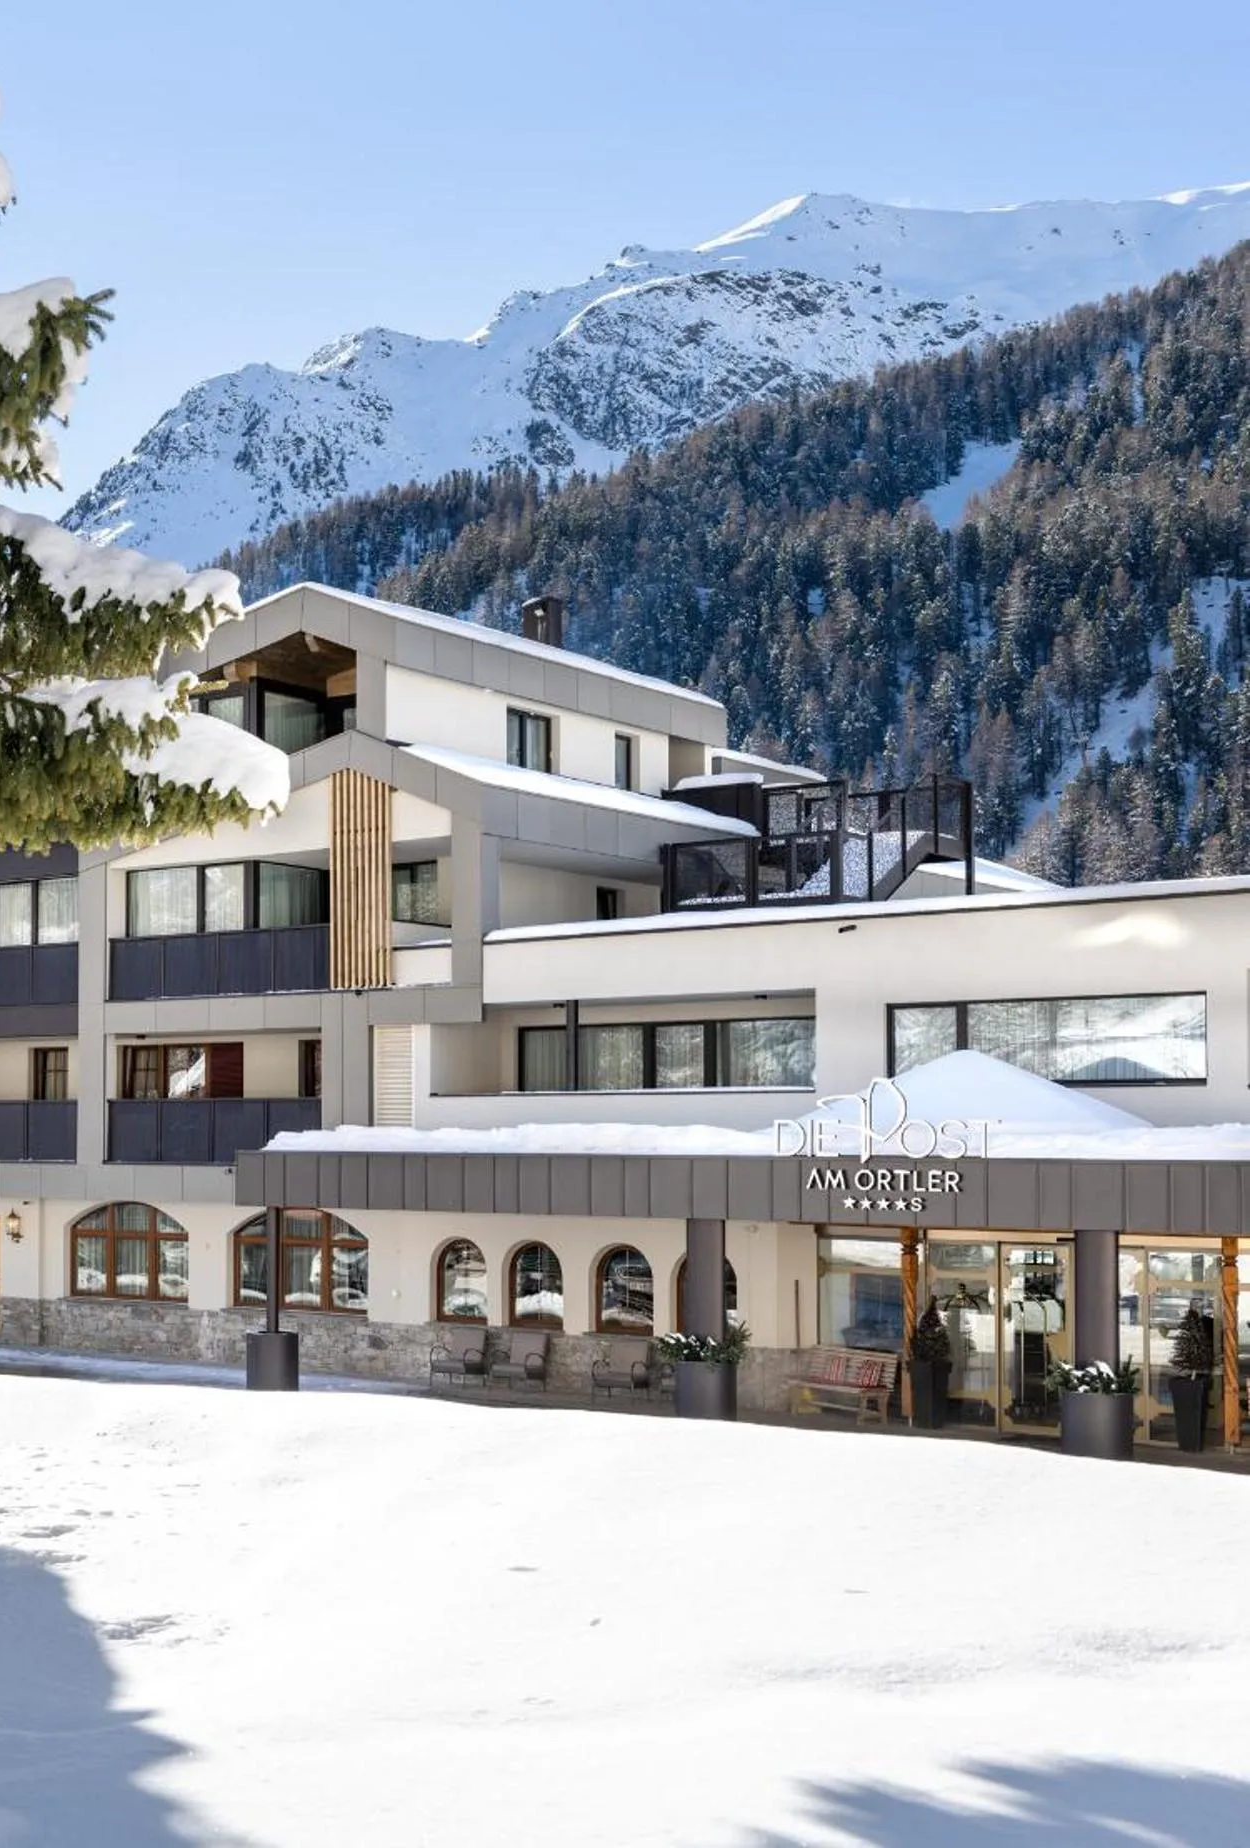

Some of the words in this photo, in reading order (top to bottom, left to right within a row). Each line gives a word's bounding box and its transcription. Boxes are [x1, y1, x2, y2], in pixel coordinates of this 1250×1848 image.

[773, 1118, 841, 1158] DIE
[816, 1077, 1002, 1164] POST
[806, 1167, 848, 1191] AM
[854, 1168, 963, 1194] ORTLER
